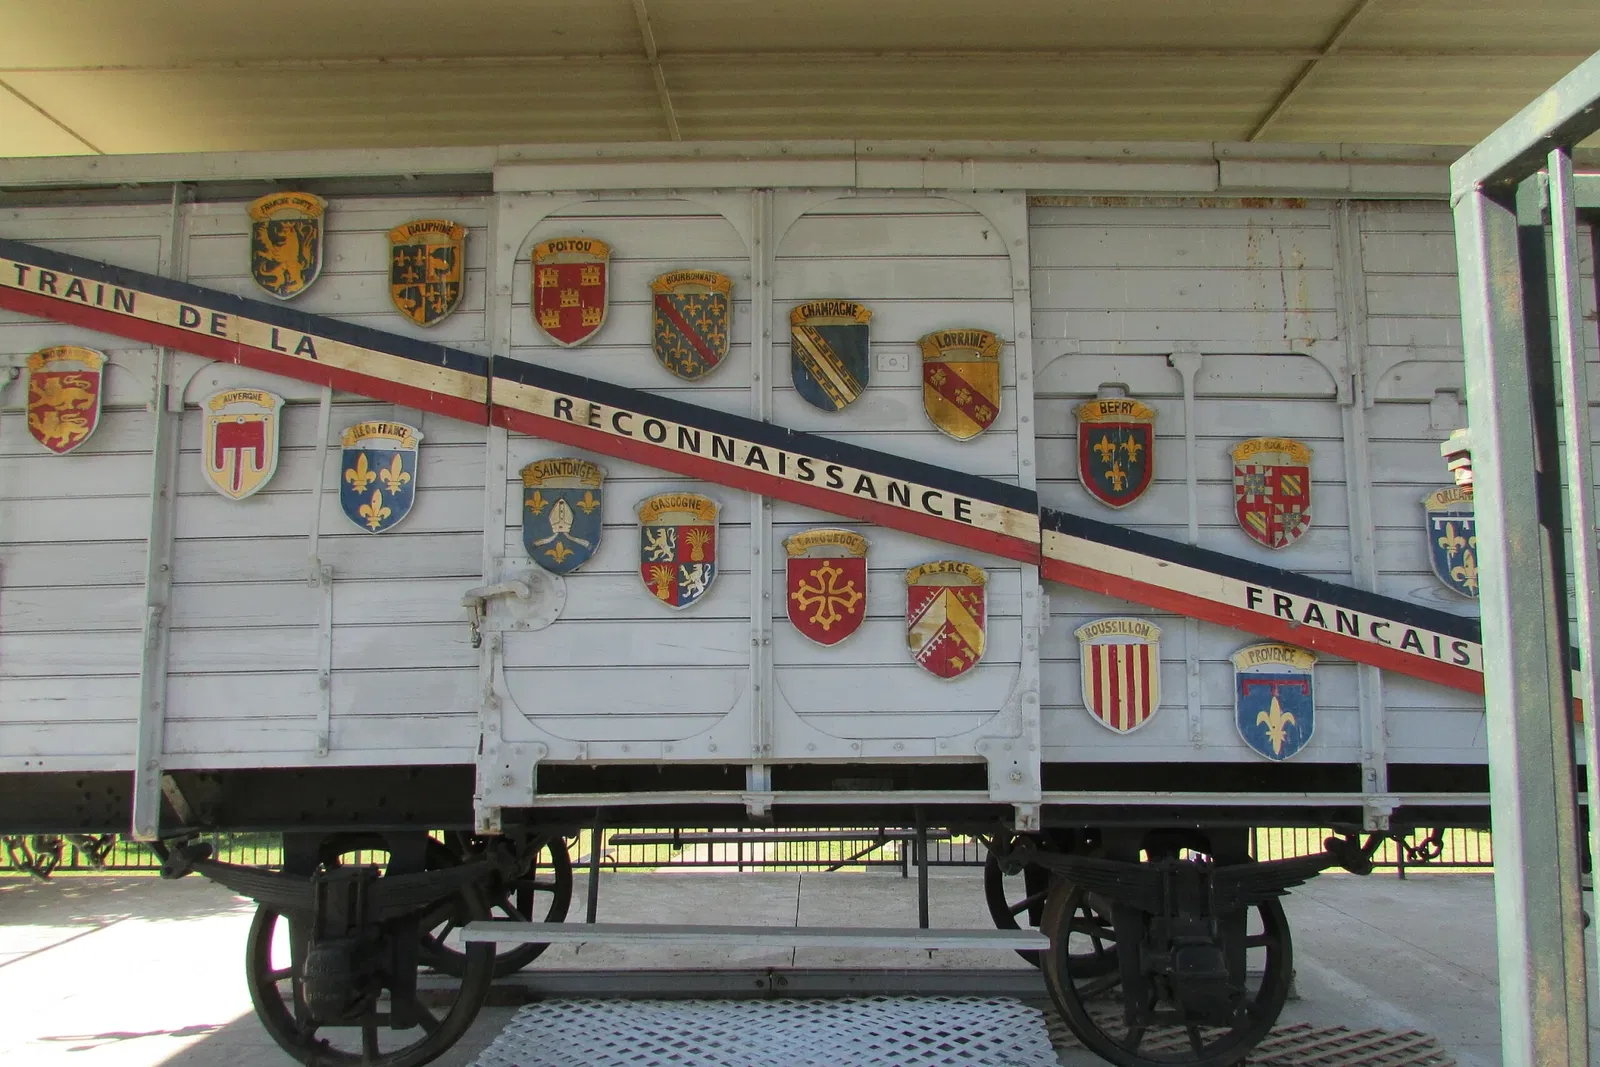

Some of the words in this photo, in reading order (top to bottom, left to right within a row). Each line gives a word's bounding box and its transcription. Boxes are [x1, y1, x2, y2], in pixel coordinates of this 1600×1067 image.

[548, 240, 592, 253] POITOU
[666, 271, 717, 285] BOURBONNAIS
[802, 302, 858, 317] CHAMPAGNE
[936, 333, 988, 349] LORRAINE
[223, 392, 263, 403] AUVERGNE
[1099, 401, 1134, 414] BERRY
[378, 423, 408, 438] FRANCE
[13, 263, 136, 314] TRAIN
[179, 304, 228, 337] DE
[271, 328, 318, 360] LA
[553, 397, 972, 524] RECONNAISSANCE
[1246, 586, 1483, 668] FRANCAIS
[534, 462, 593, 479] SAINTONGE
[651, 497, 701, 512] GASCOGNE
[796, 533, 859, 546] LANGUEDOC
[919, 562, 969, 576] ALSACE
[1085, 621, 1149, 638] ROUSSILLON
[1248, 647, 1296, 664] PROVENCE
